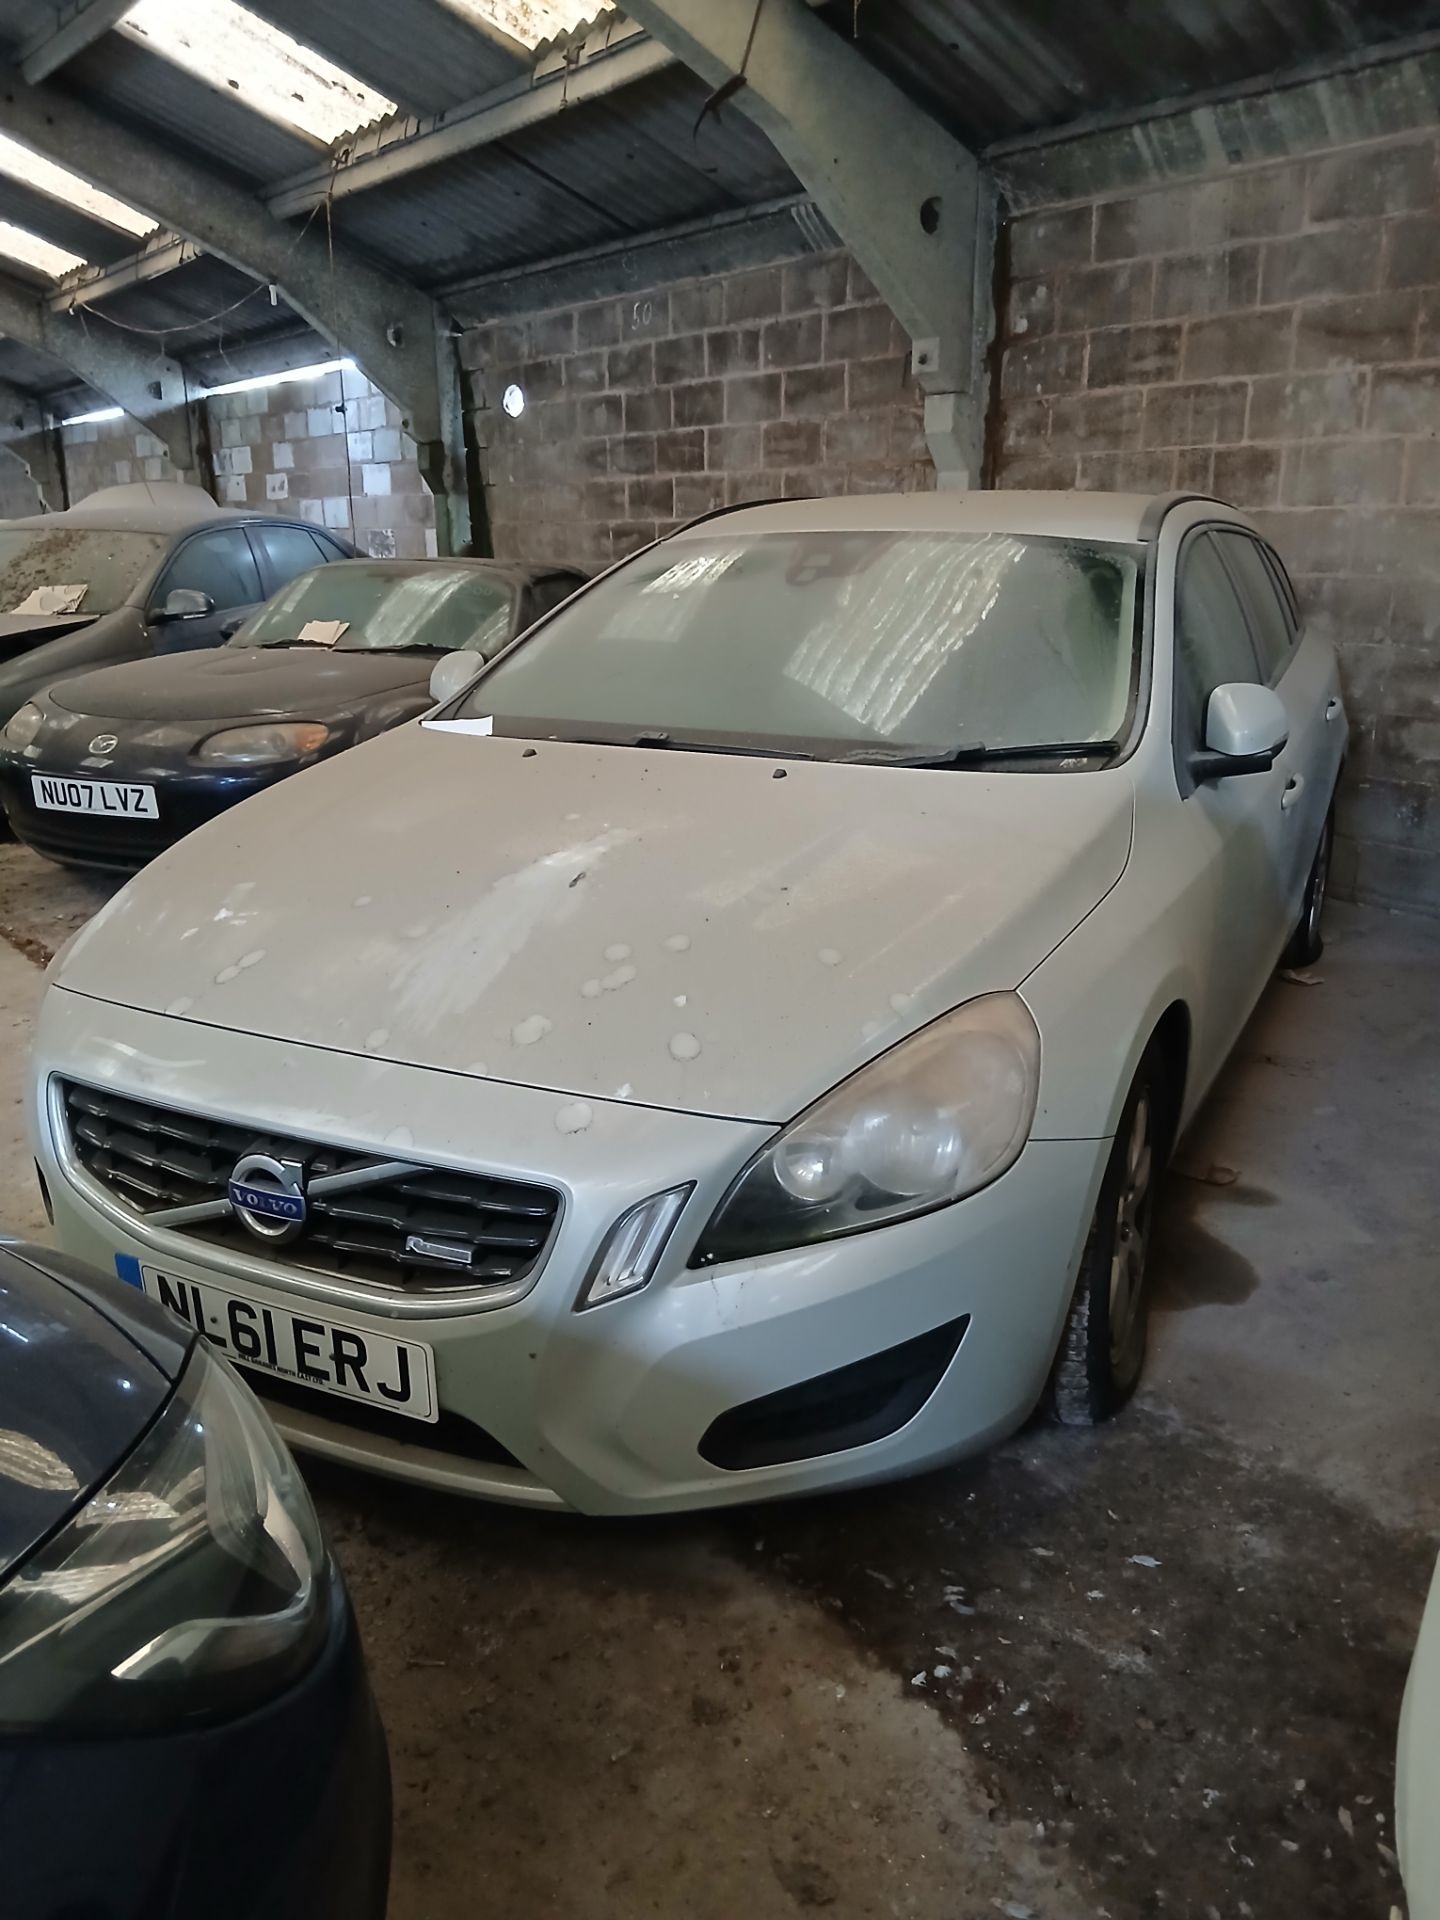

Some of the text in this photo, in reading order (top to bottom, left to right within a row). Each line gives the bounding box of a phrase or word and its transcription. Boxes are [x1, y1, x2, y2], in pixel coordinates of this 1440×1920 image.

[40, 779, 148, 813] NU07 LVZ
[233, 1188, 298, 1215] VOLVO
[156, 1275, 412, 1402] NL61 ERJ
